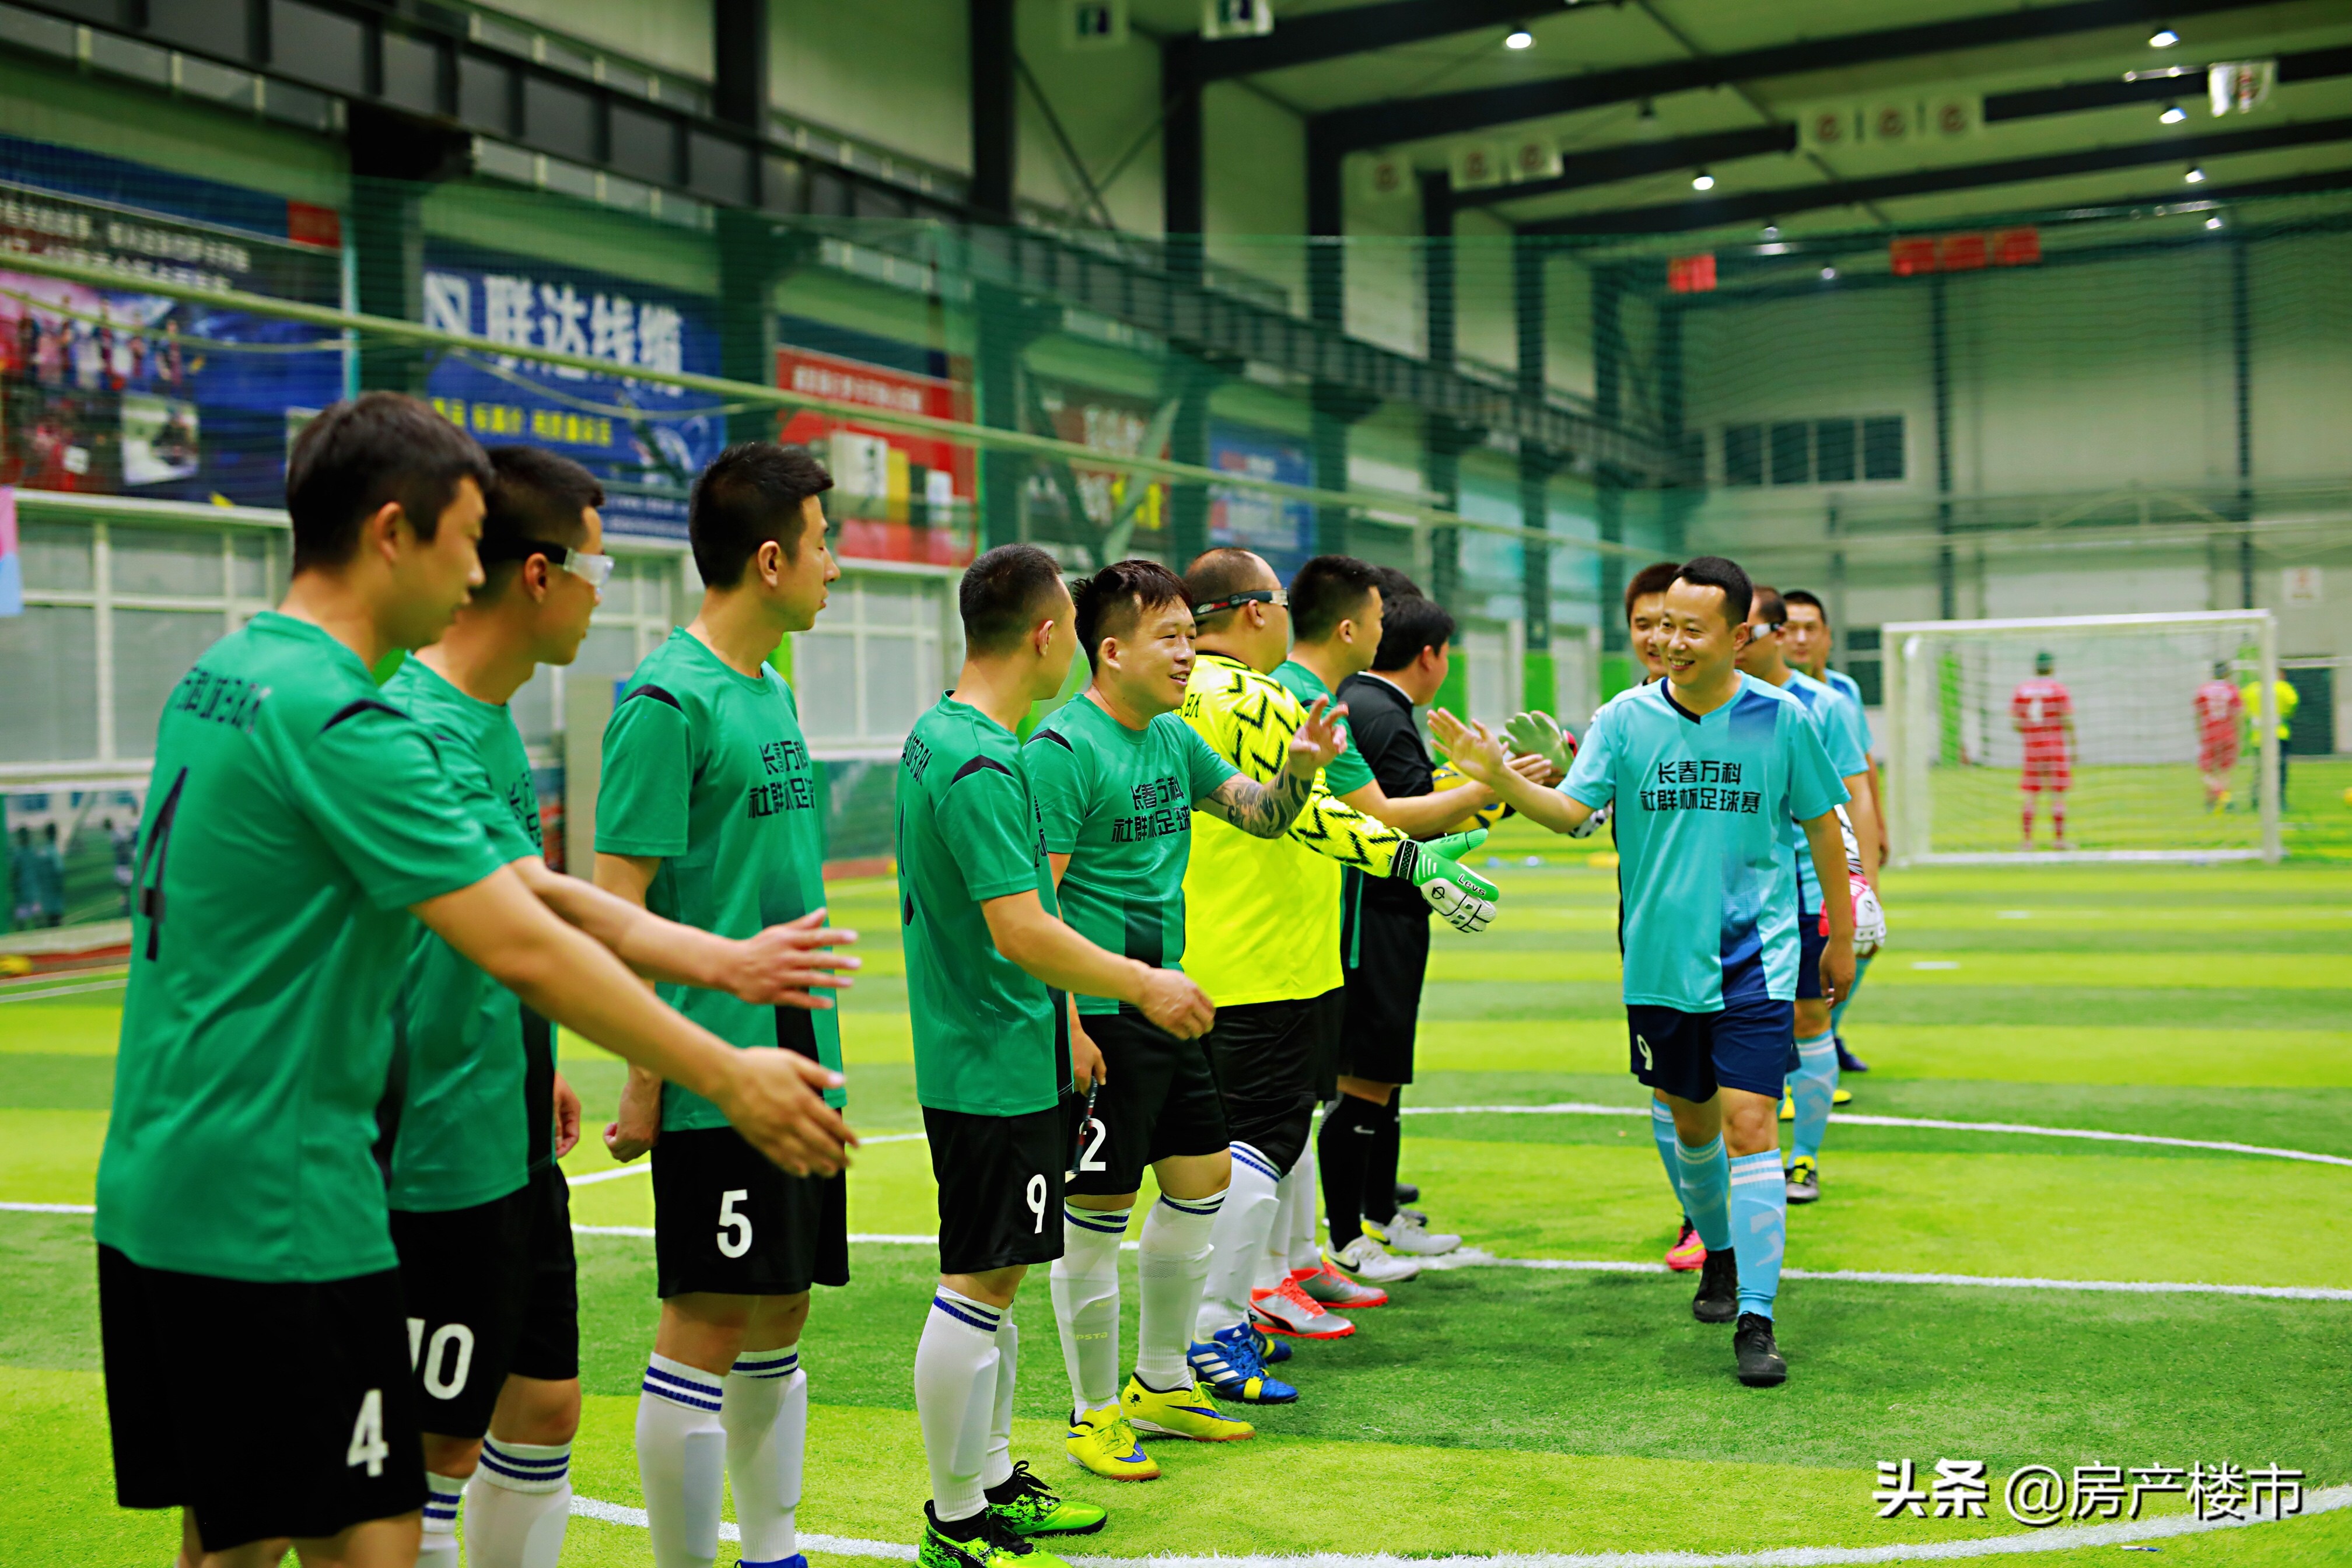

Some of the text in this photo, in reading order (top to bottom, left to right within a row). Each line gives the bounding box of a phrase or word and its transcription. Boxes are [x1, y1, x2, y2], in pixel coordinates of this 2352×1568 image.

[1658, 760, 1741, 785] 长春万科
[1130, 775, 1185, 811] 长春万科
[1639, 787, 1762, 814] 社群杯足球赛
[1458, 874, 1486, 896] Levs
[1636, 1034, 1653, 1071] 9
[1079, 1118, 1107, 1171] 2
[1026, 1174, 1047, 1234] 9
[716, 1189, 752, 1258] 5
[346, 1388, 389, 1478] 4
